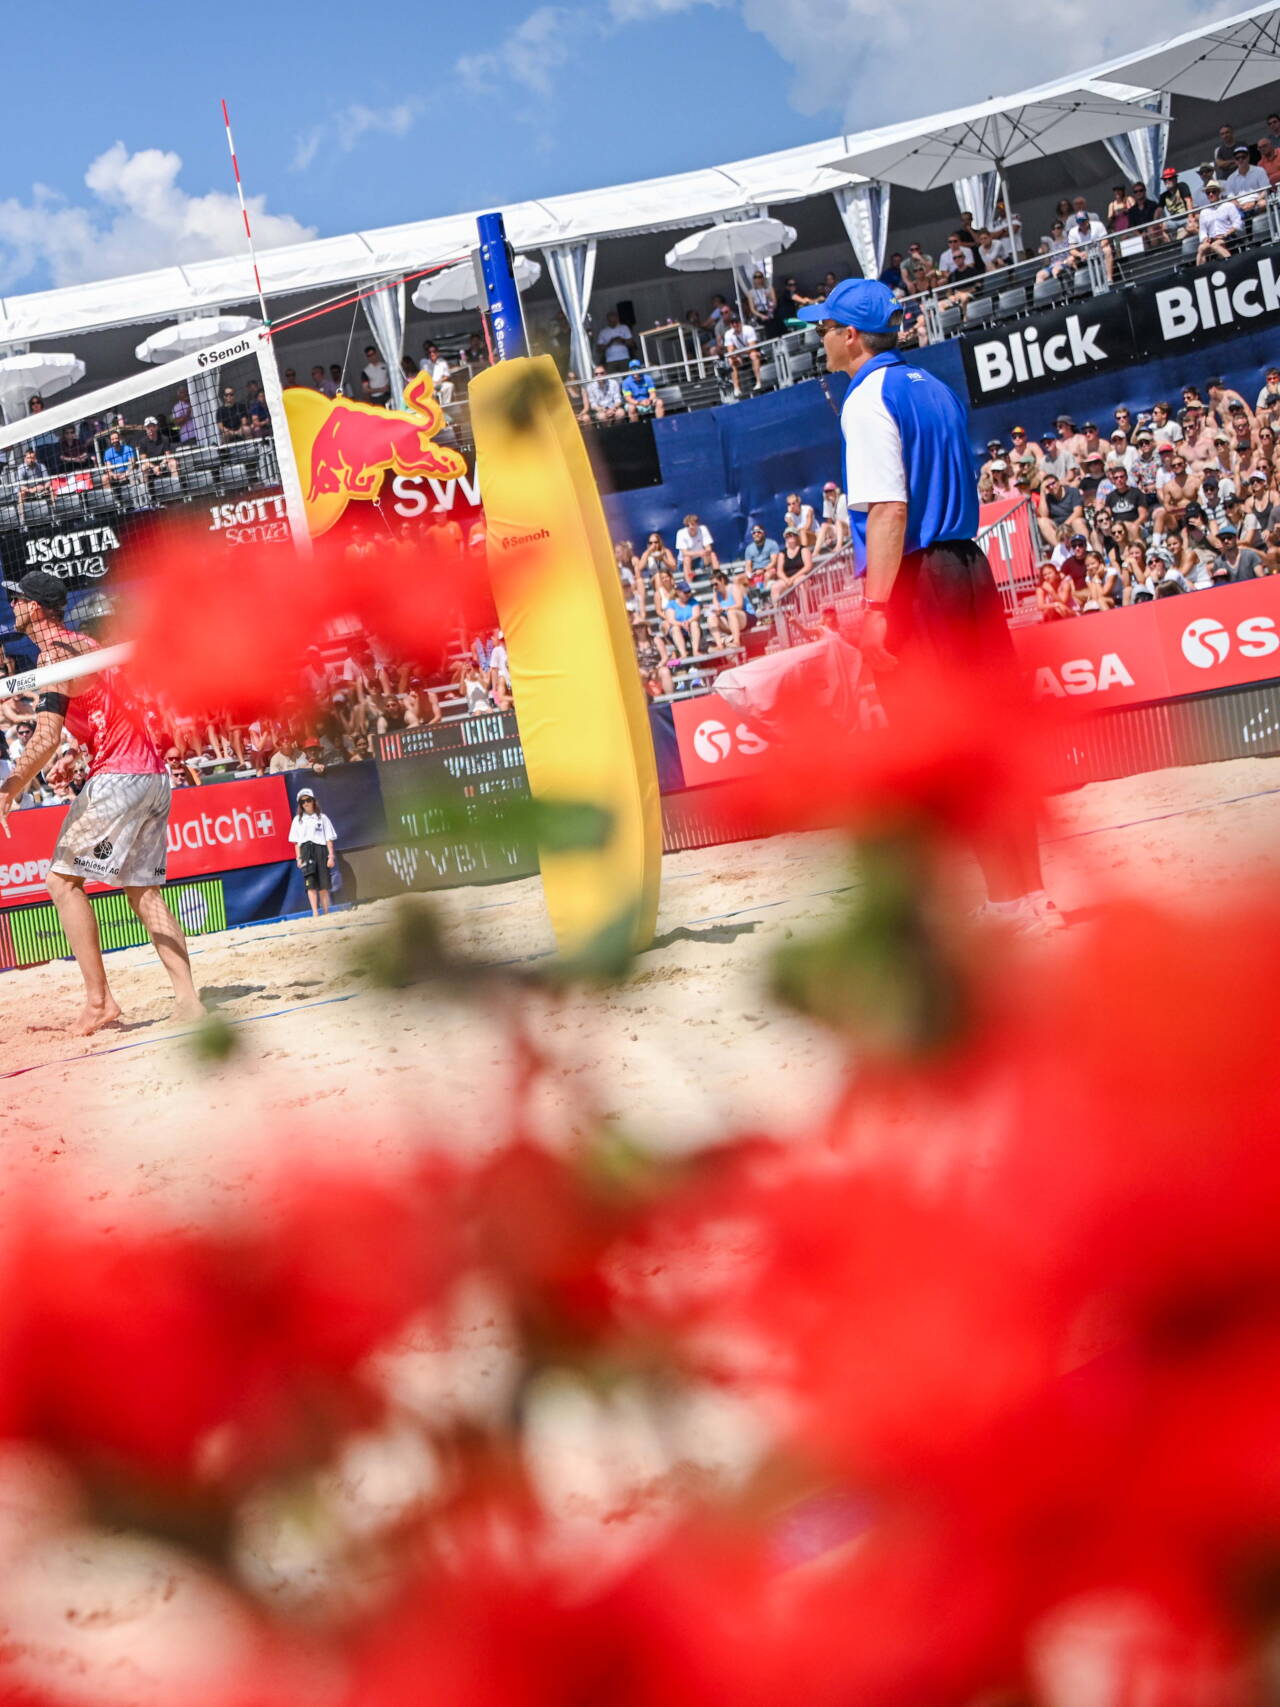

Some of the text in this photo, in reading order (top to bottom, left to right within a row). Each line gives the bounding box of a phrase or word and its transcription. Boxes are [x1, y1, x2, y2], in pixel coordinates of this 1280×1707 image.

[1155, 258, 1280, 341] Blick
[209, 340, 250, 363] Senoh
[974, 315, 1108, 393] Blick
[225, 521, 289, 546] senza
[510, 529, 550, 547] Senoh
[41, 555, 108, 579] senza
[17, 677, 35, 687] BEACH
[1033, 652, 1135, 700] ASA
[167, 808, 254, 852] watch
[73, 857, 108, 873] Stahlesel
[109, 868, 119, 876] AG
[154, 867, 166, 876] He
